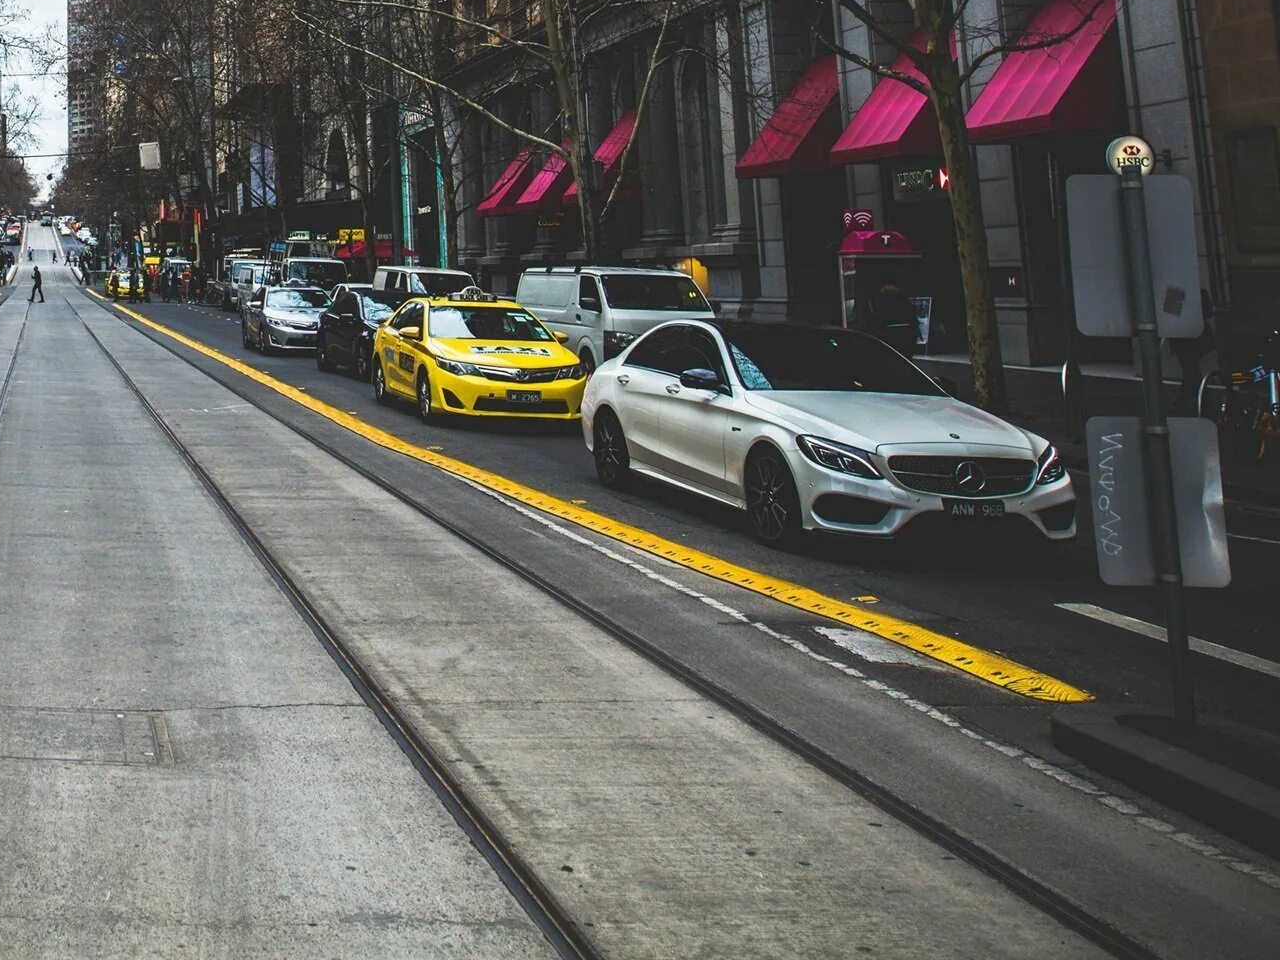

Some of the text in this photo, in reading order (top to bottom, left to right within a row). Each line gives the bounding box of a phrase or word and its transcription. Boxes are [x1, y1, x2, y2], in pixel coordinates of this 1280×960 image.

[1116, 156, 1150, 168] HSBC
[471, 346, 549, 354] TAXI
[521, 394, 540, 402] 2765
